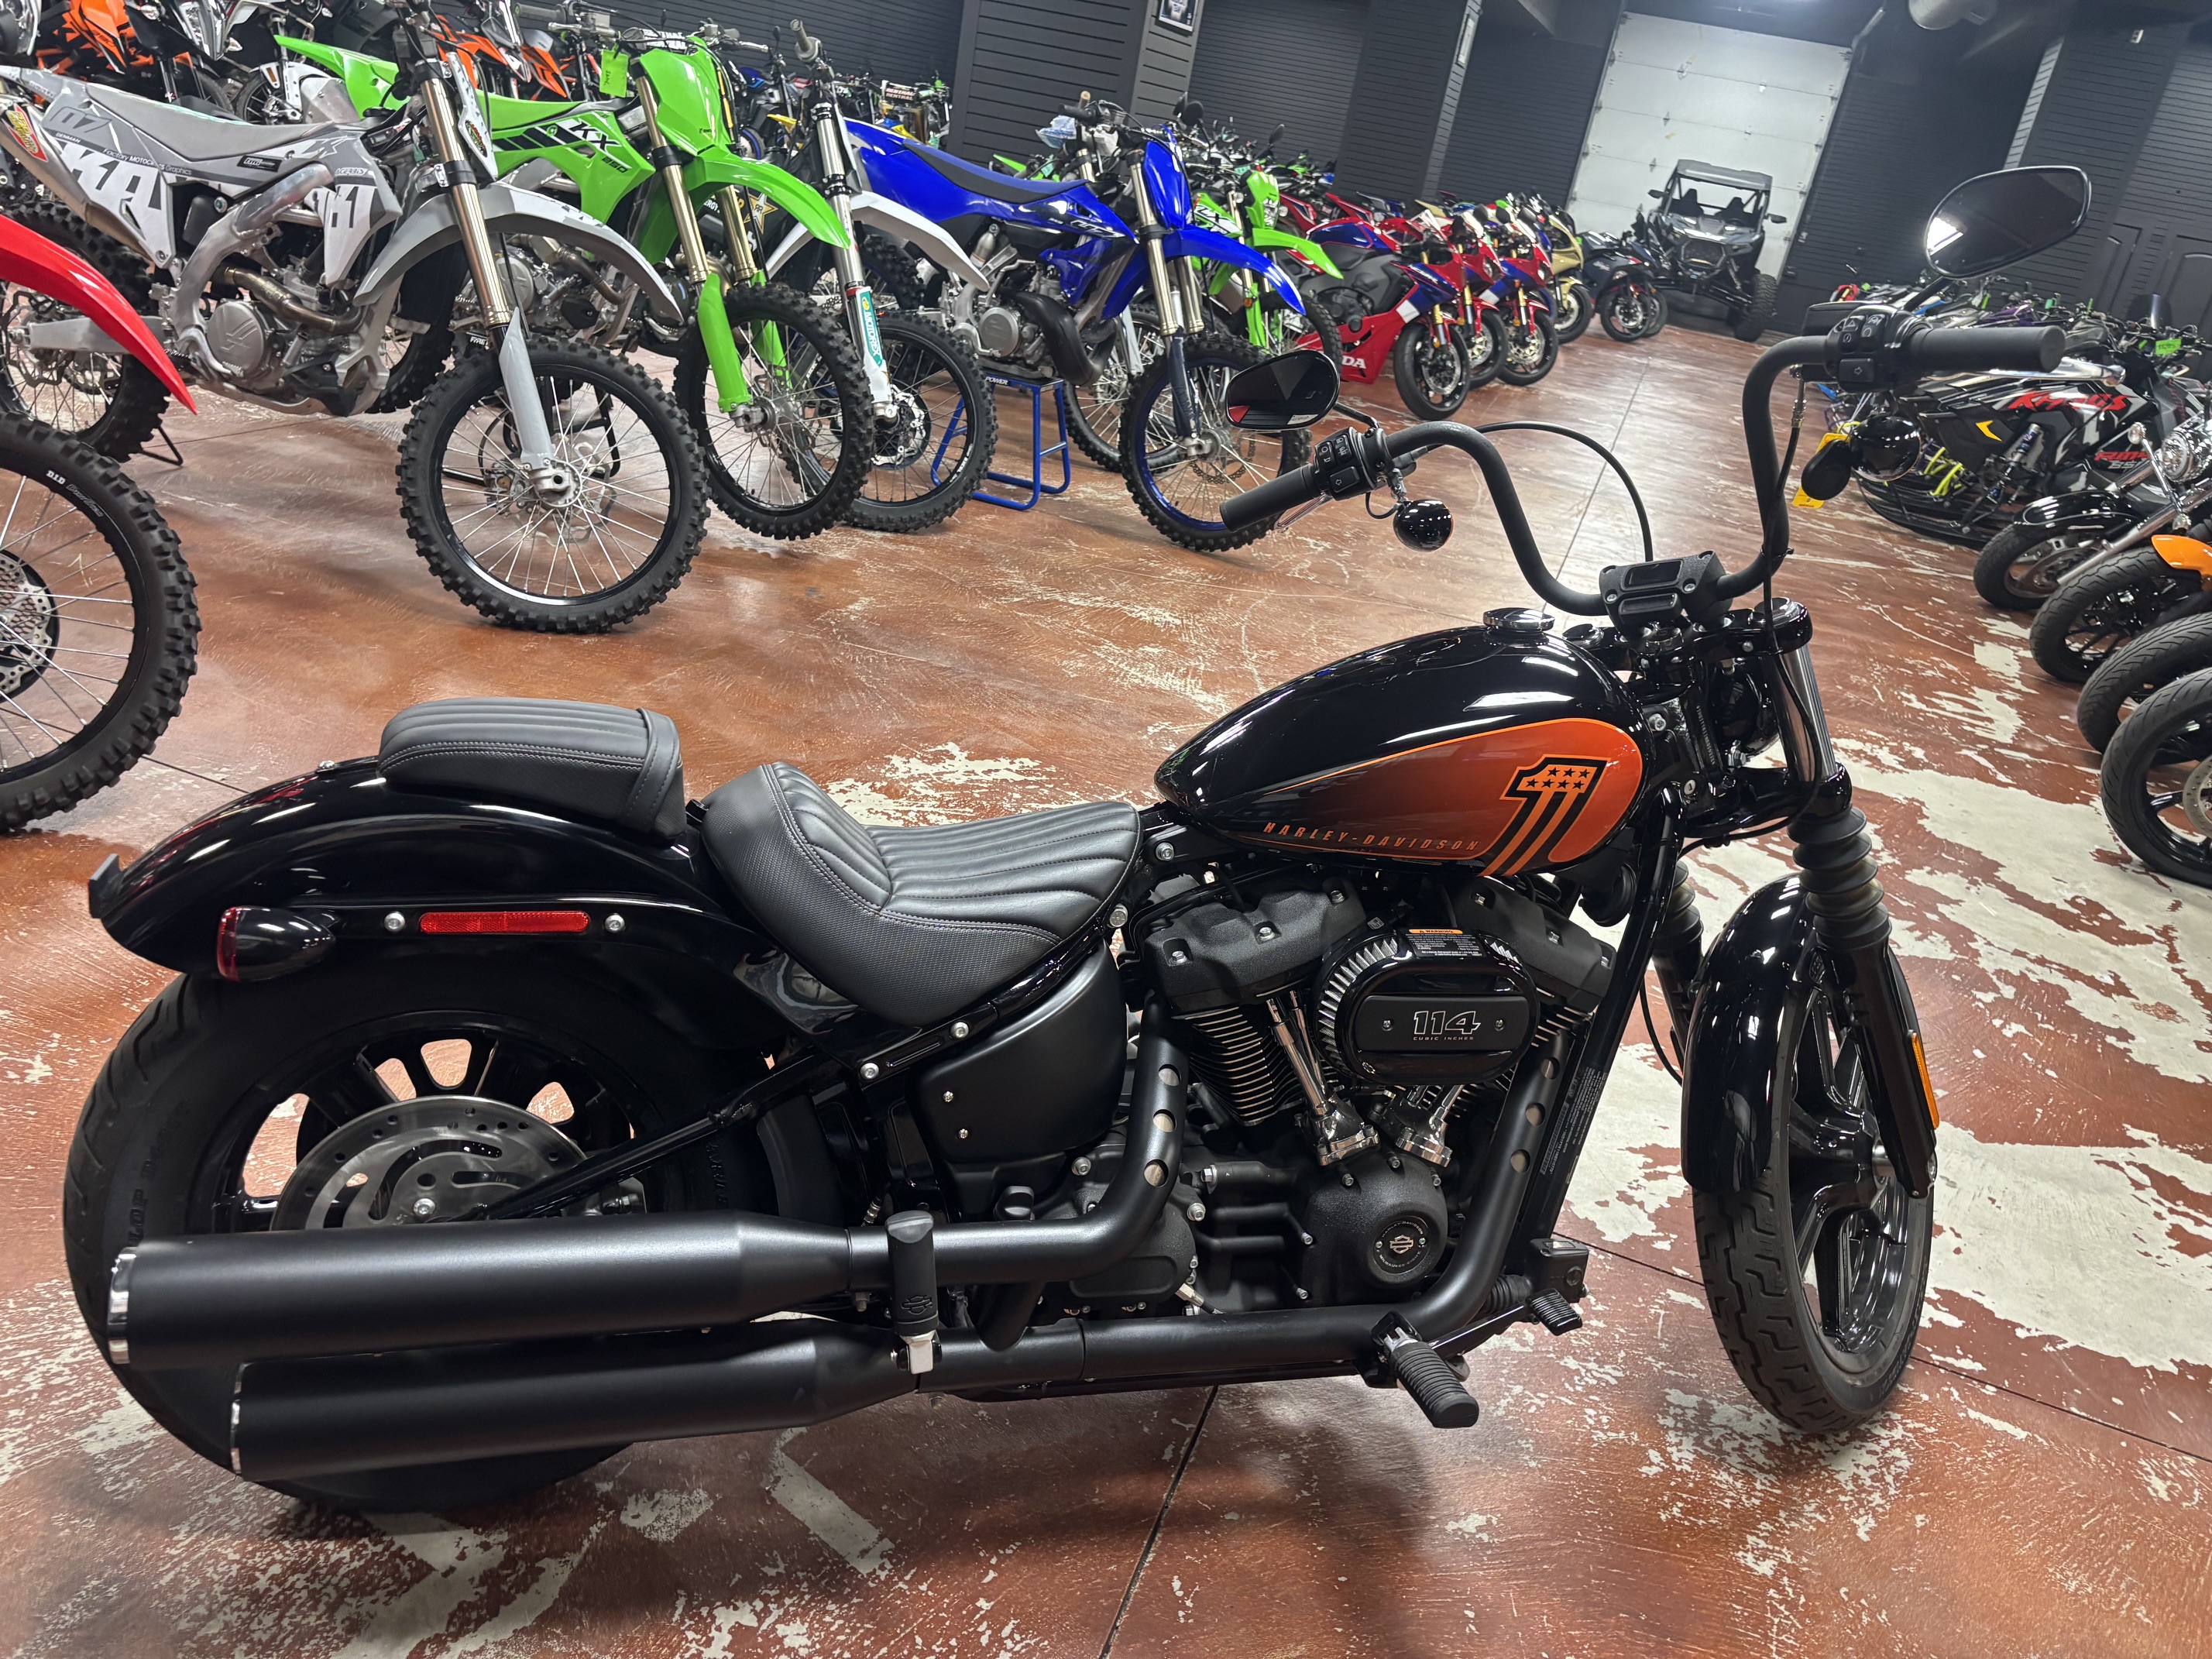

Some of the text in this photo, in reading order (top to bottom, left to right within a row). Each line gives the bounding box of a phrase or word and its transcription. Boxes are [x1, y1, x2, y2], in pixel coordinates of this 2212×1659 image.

[569, 122, 622, 153] KX
[103, 148, 129, 161] Factory
[165, 165, 192, 176] Graphics
[601, 156, 629, 173] 250
[864, 311, 881, 356] MOTOREX
[1263, 822, 1480, 850] HARLEY-DAVIDSON
[1413, 1010, 1482, 1035] 114
[1382, 1221, 1424, 1238] HARLEY-DAVIDSON
